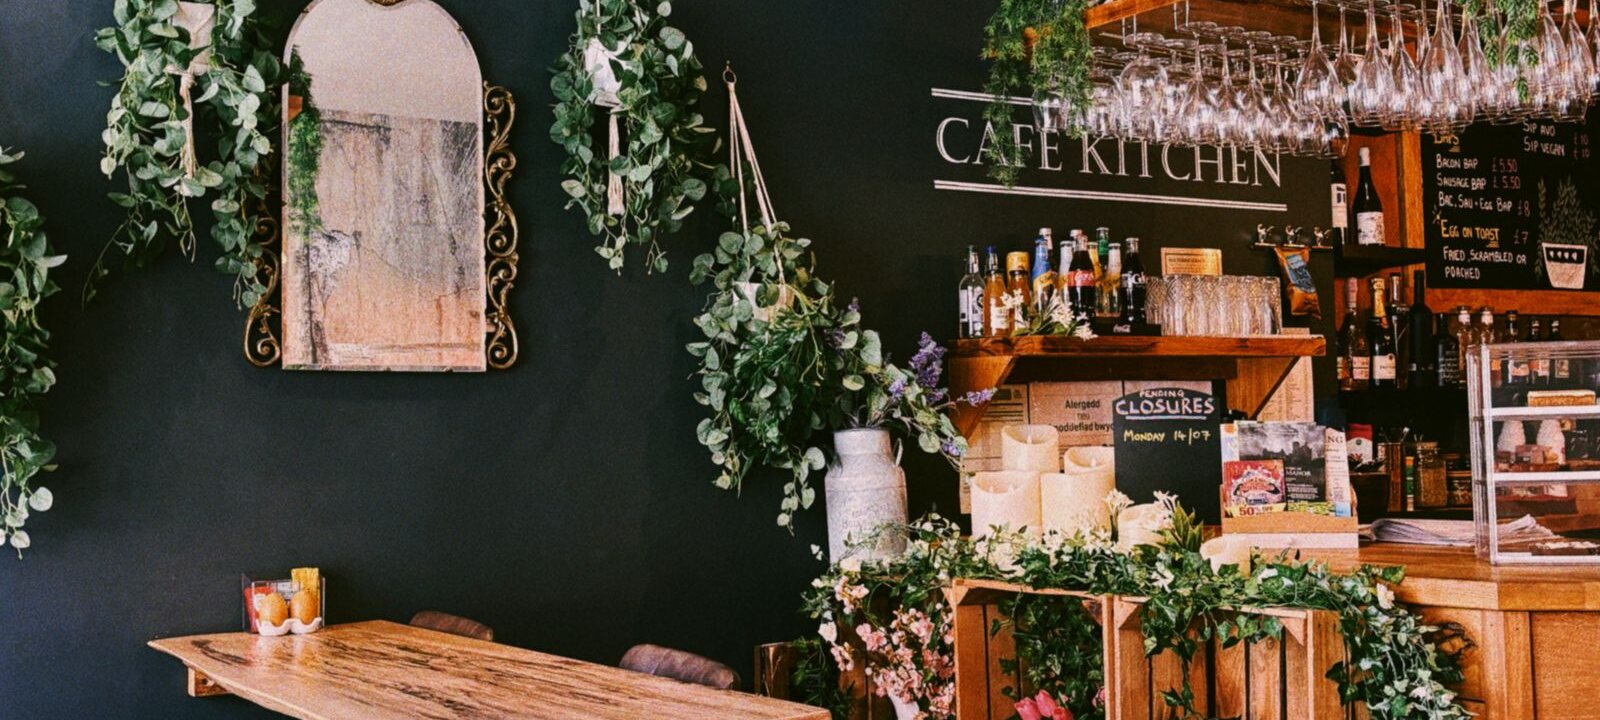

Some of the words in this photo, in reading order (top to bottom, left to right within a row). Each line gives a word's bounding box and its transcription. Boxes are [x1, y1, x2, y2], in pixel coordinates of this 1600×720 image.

[1079, 131, 1281, 188] KITCHEN
[1436, 153, 1461, 169] BACON
[1463, 158, 1479, 170] BAP
[1436, 172, 1470, 188] SAUSAGE
[1471, 177, 1487, 191] BAP
[1496, 197, 1513, 213] BAP
[1440, 219, 1460, 238] EGG
[1462, 226, 1474, 238] ON
[1474, 226, 1500, 241] TOAST
[1469, 249, 1514, 264] SCRAMBLED
[1516, 254, 1527, 265] OR
[1444, 265, 1481, 280] POACHED
[1139, 389, 1186, 398] PENDING
[1065, 400, 1101, 410] Alergedd
[1115, 396, 1216, 415] CLOSURES
[1049, 422, 1094, 433] noddefiad
[1123, 429, 1166, 443] MONDAY
[1173, 427, 1212, 446] 14/07
